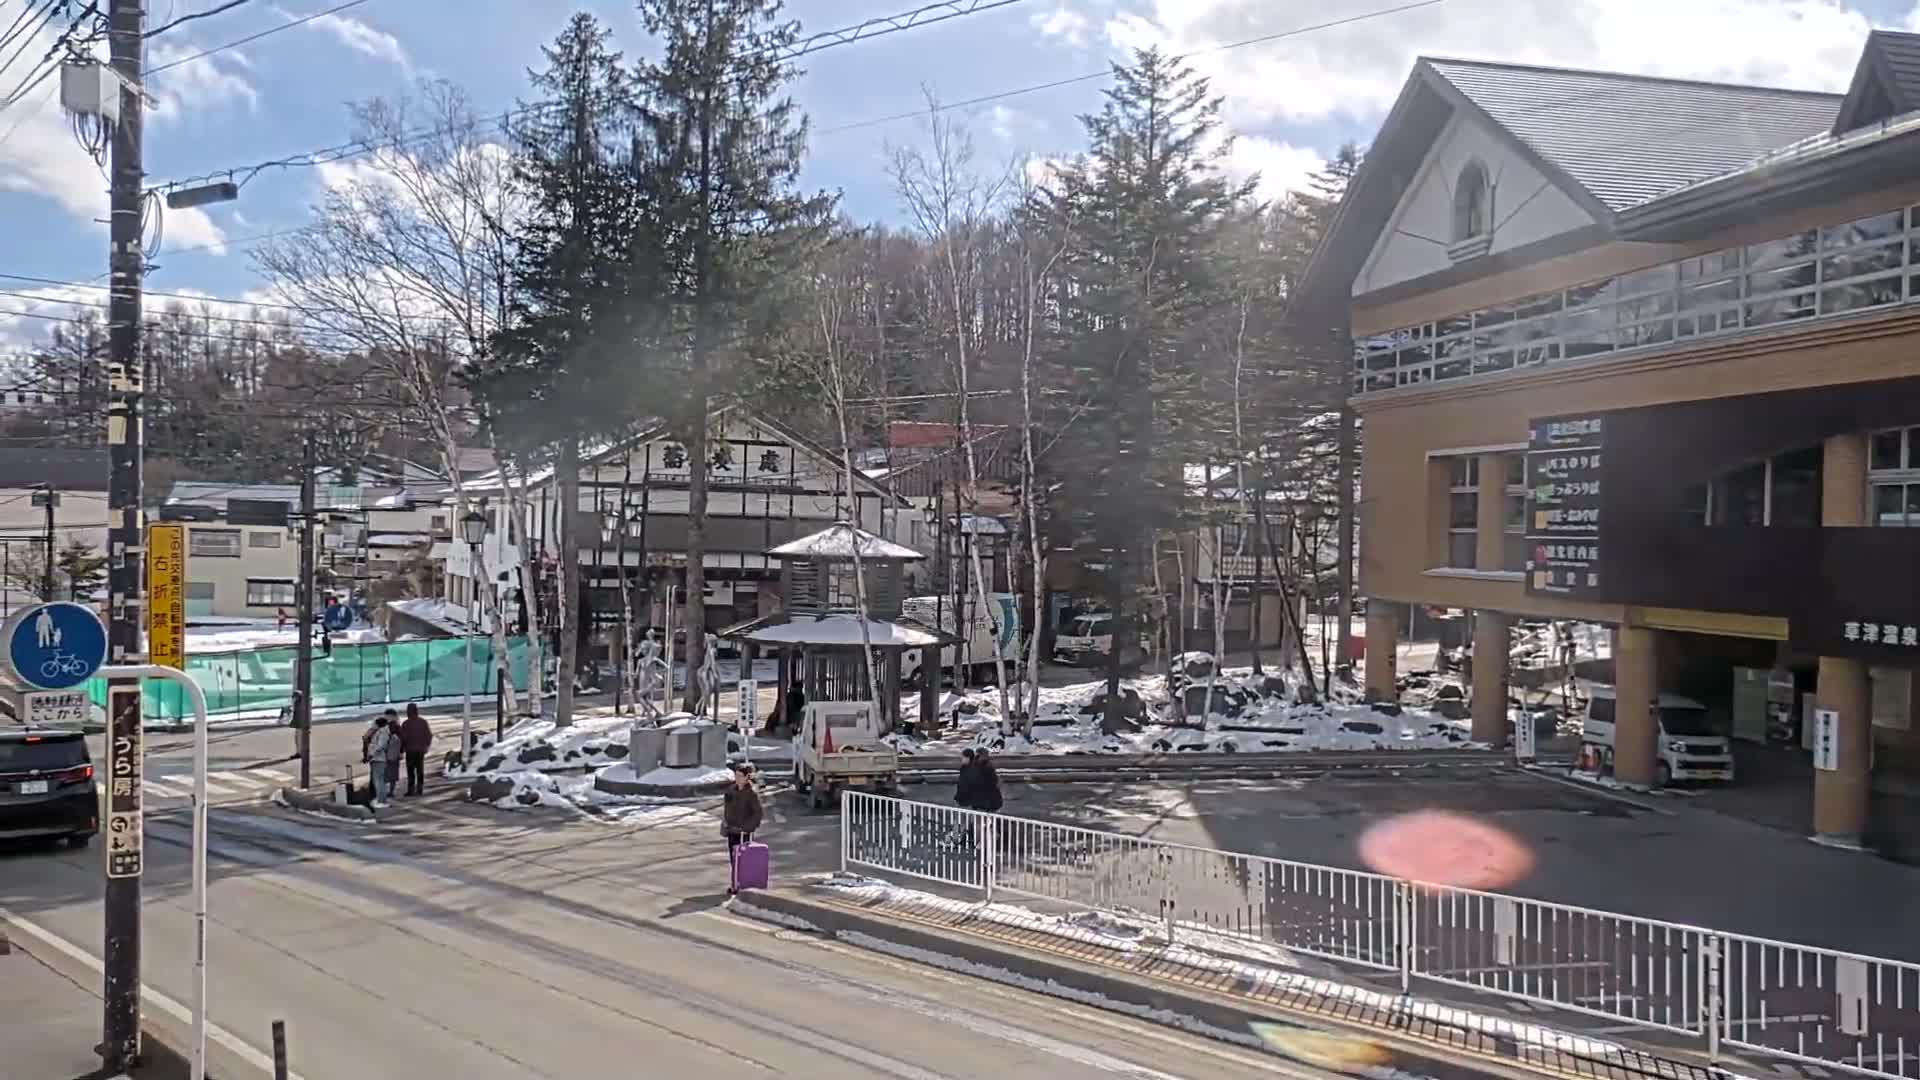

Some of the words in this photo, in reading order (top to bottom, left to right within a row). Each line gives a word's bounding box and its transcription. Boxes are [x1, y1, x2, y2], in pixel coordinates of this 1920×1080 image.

[152, 556, 169, 657] 右折禁止
[1844, 622, 1918, 646] 草津温泉
[31, 707, 82, 721] ここから
